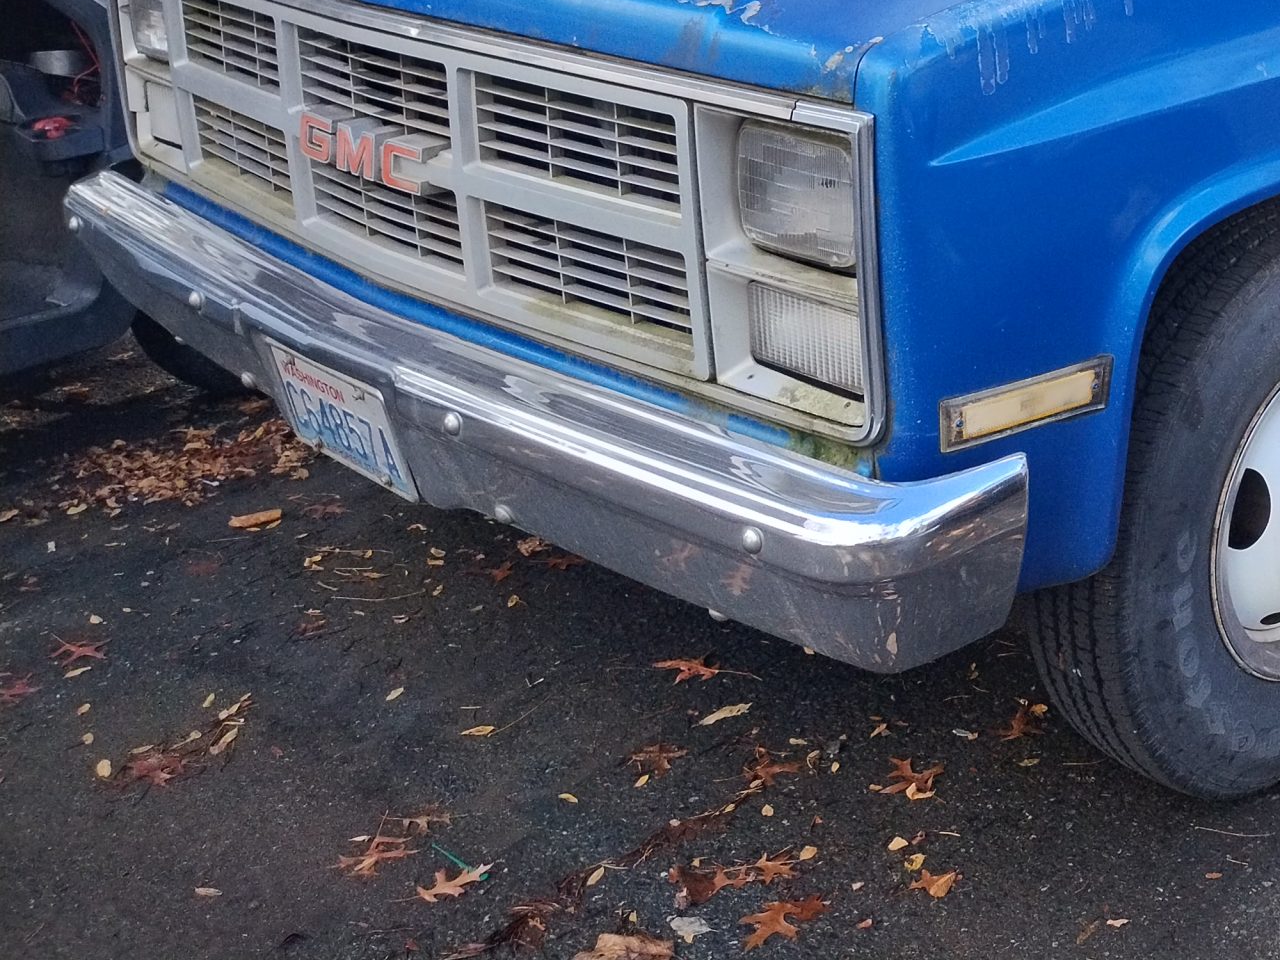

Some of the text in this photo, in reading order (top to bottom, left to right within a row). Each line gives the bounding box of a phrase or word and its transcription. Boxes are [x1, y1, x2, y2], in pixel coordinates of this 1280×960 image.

[299, 111, 423, 196] GMC
[281, 363, 345, 404] WASHINGTON
[285, 380, 402, 480] C64857A
